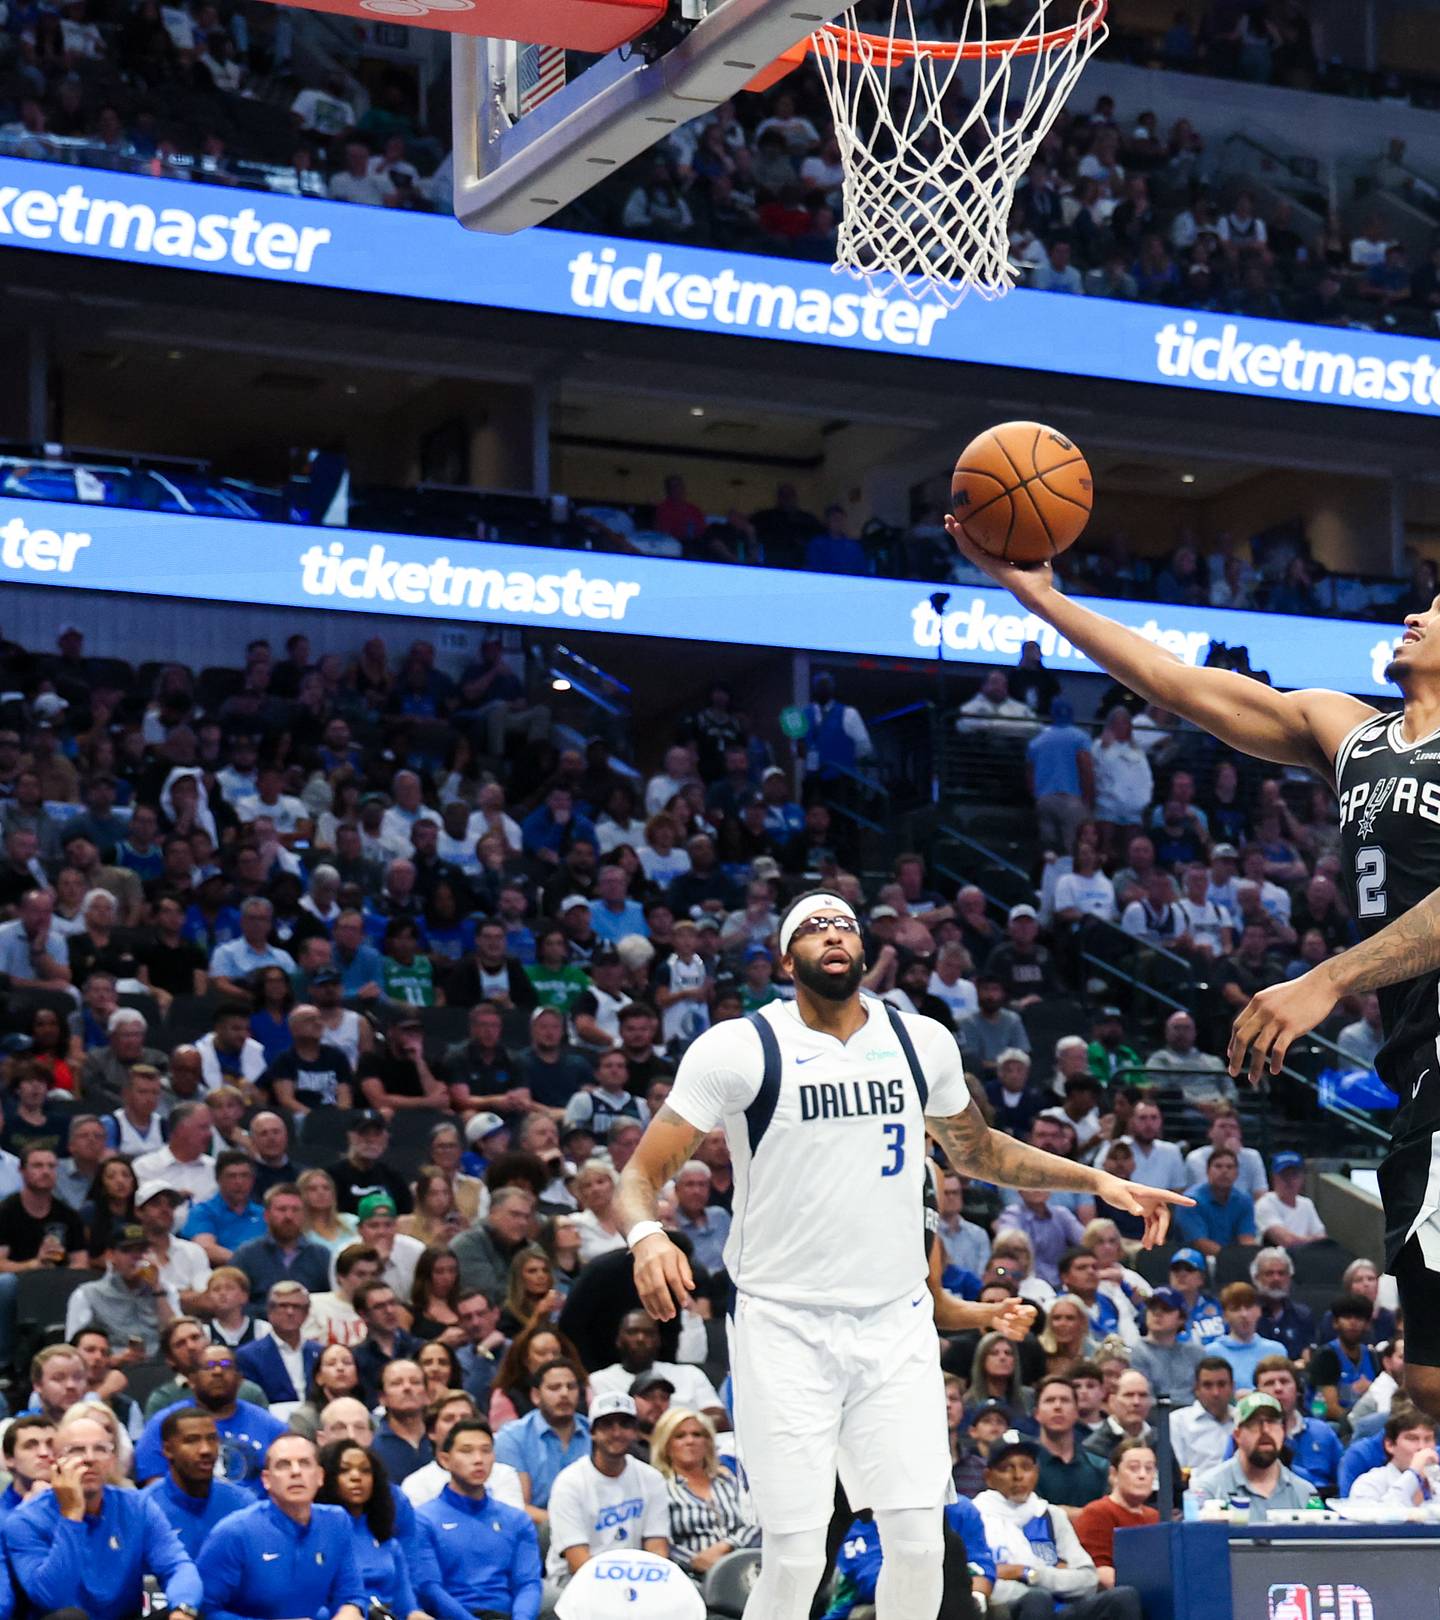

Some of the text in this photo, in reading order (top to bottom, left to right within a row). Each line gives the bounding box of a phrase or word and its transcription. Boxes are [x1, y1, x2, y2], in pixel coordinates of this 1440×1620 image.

[569, 247, 948, 346] ticketmaster
[0, 517, 92, 573] ter
[299, 542, 641, 620] ticketmaster
[1355, 845, 1388, 919] 2
[799, 1078, 906, 1121] DALLAS
[880, 1122, 906, 1177] 3
[594, 1565, 671, 1583] LOUD!
